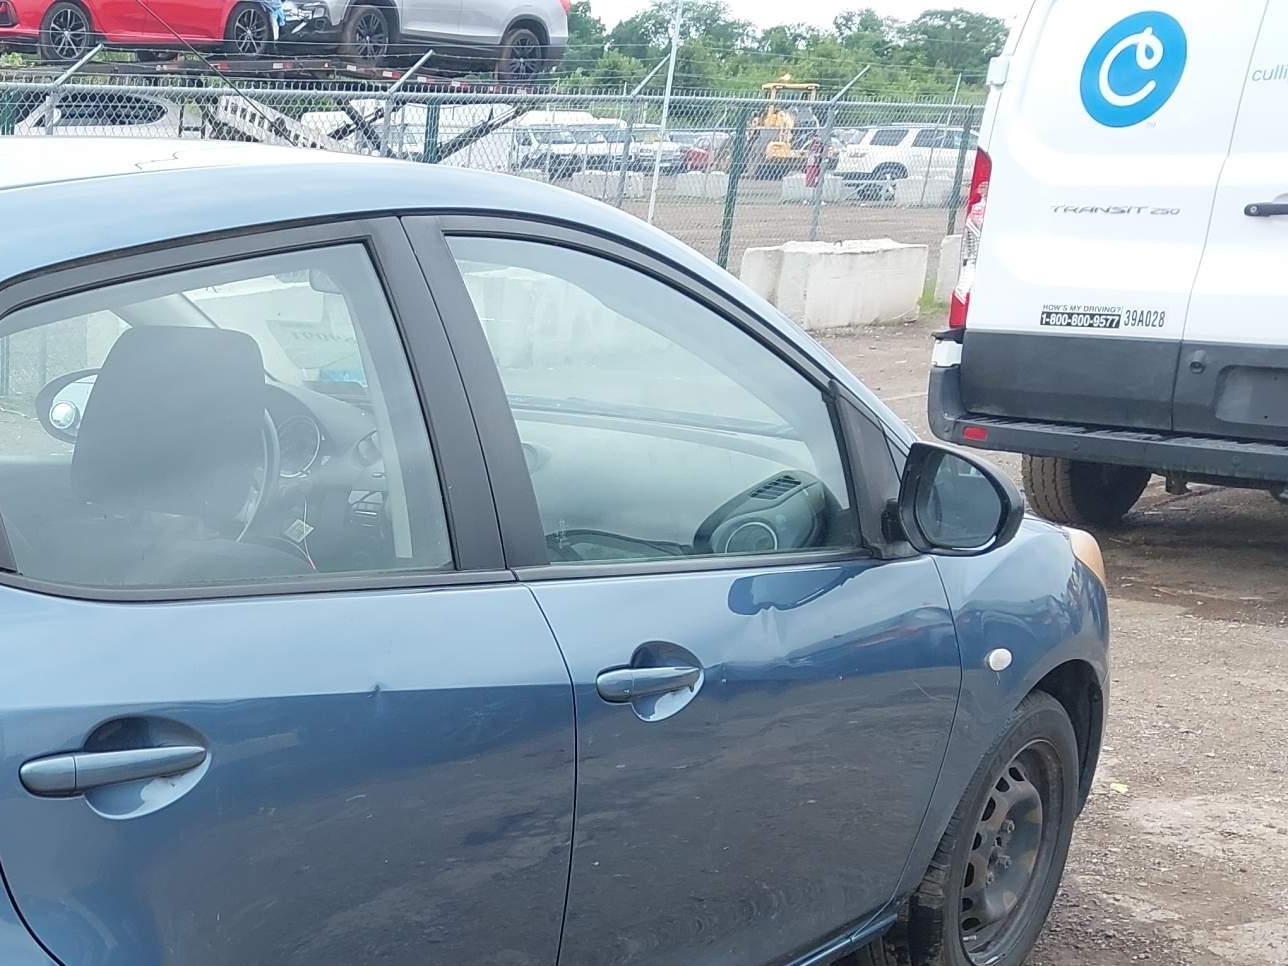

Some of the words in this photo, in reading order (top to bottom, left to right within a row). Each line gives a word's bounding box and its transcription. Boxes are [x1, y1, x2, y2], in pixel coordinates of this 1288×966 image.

[1051, 204, 1149, 215] TRANSIT
[1042, 304, 1068, 312] HOW'S
[1069, 304, 1081, 312] MY
[1083, 305, 1122, 313] DRIVING?
[1123, 309, 1166, 328] 39A028
